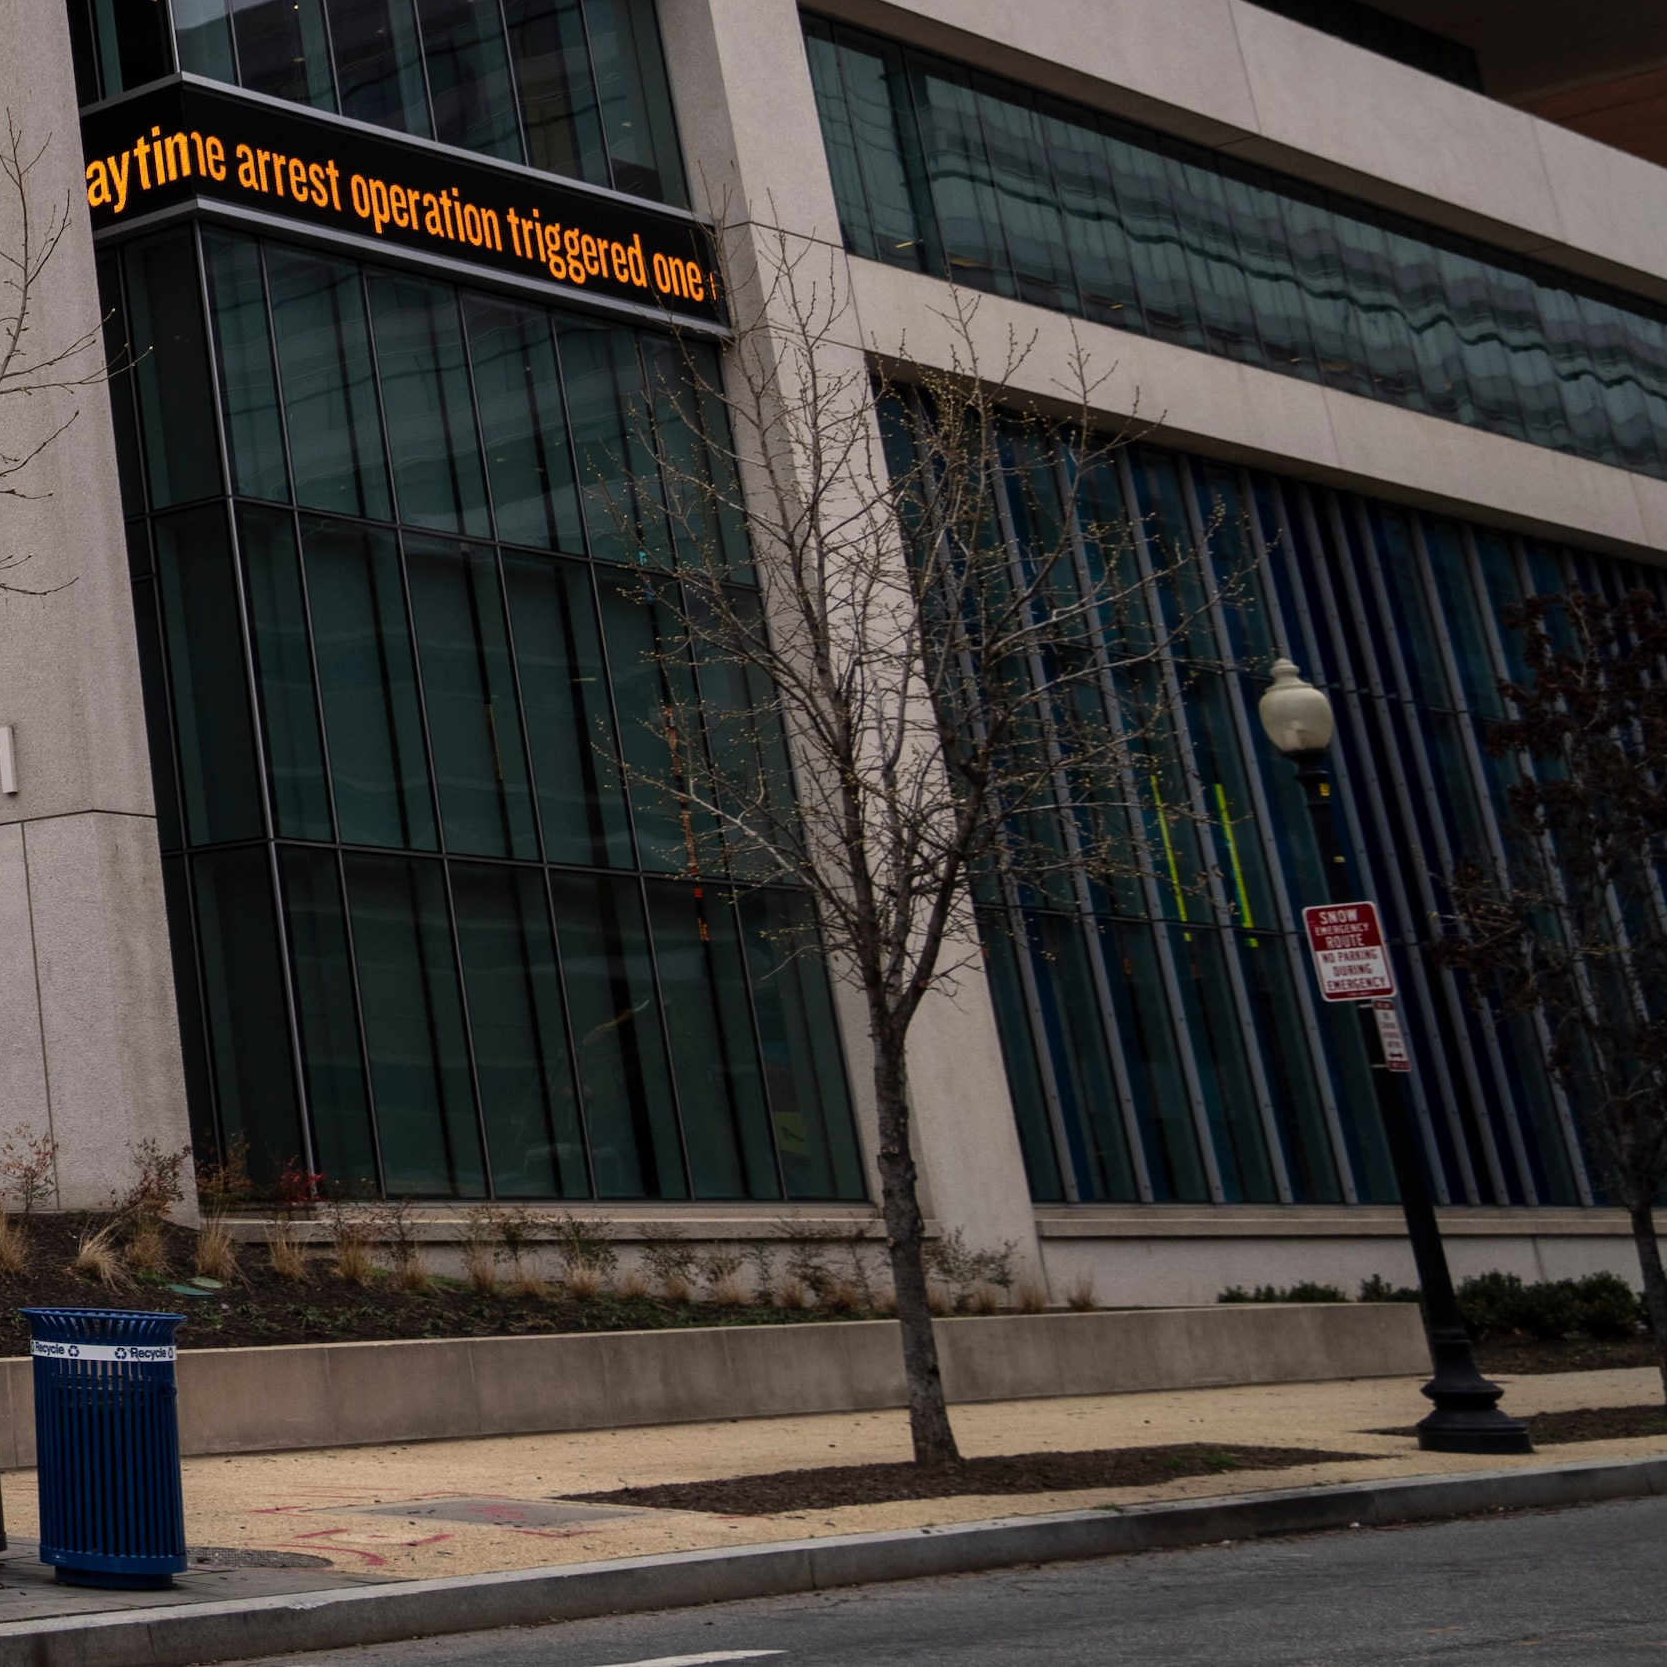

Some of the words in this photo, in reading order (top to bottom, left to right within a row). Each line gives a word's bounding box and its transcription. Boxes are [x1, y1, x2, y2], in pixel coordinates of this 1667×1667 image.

[85, 126, 227, 214] aytime
[235, 143, 342, 212] arrest
[351, 172, 503, 252] operation
[506, 206, 648, 285] triggered
[652, 251, 705, 302] one
[1318, 908, 1358, 925] SNOW
[1314, 922, 1370, 936] EMERGENCY
[1325, 933, 1365, 949] ROUTE
[1322, 952, 1336, 963] NO
[1338, 948, 1378, 962] PARKING
[1333, 963, 1373, 976] DURING
[1327, 976, 1386, 991] EMERGENCY
[35, 1341, 65, 1356] Recycle
[130, 1347, 167, 1361] Recycle
